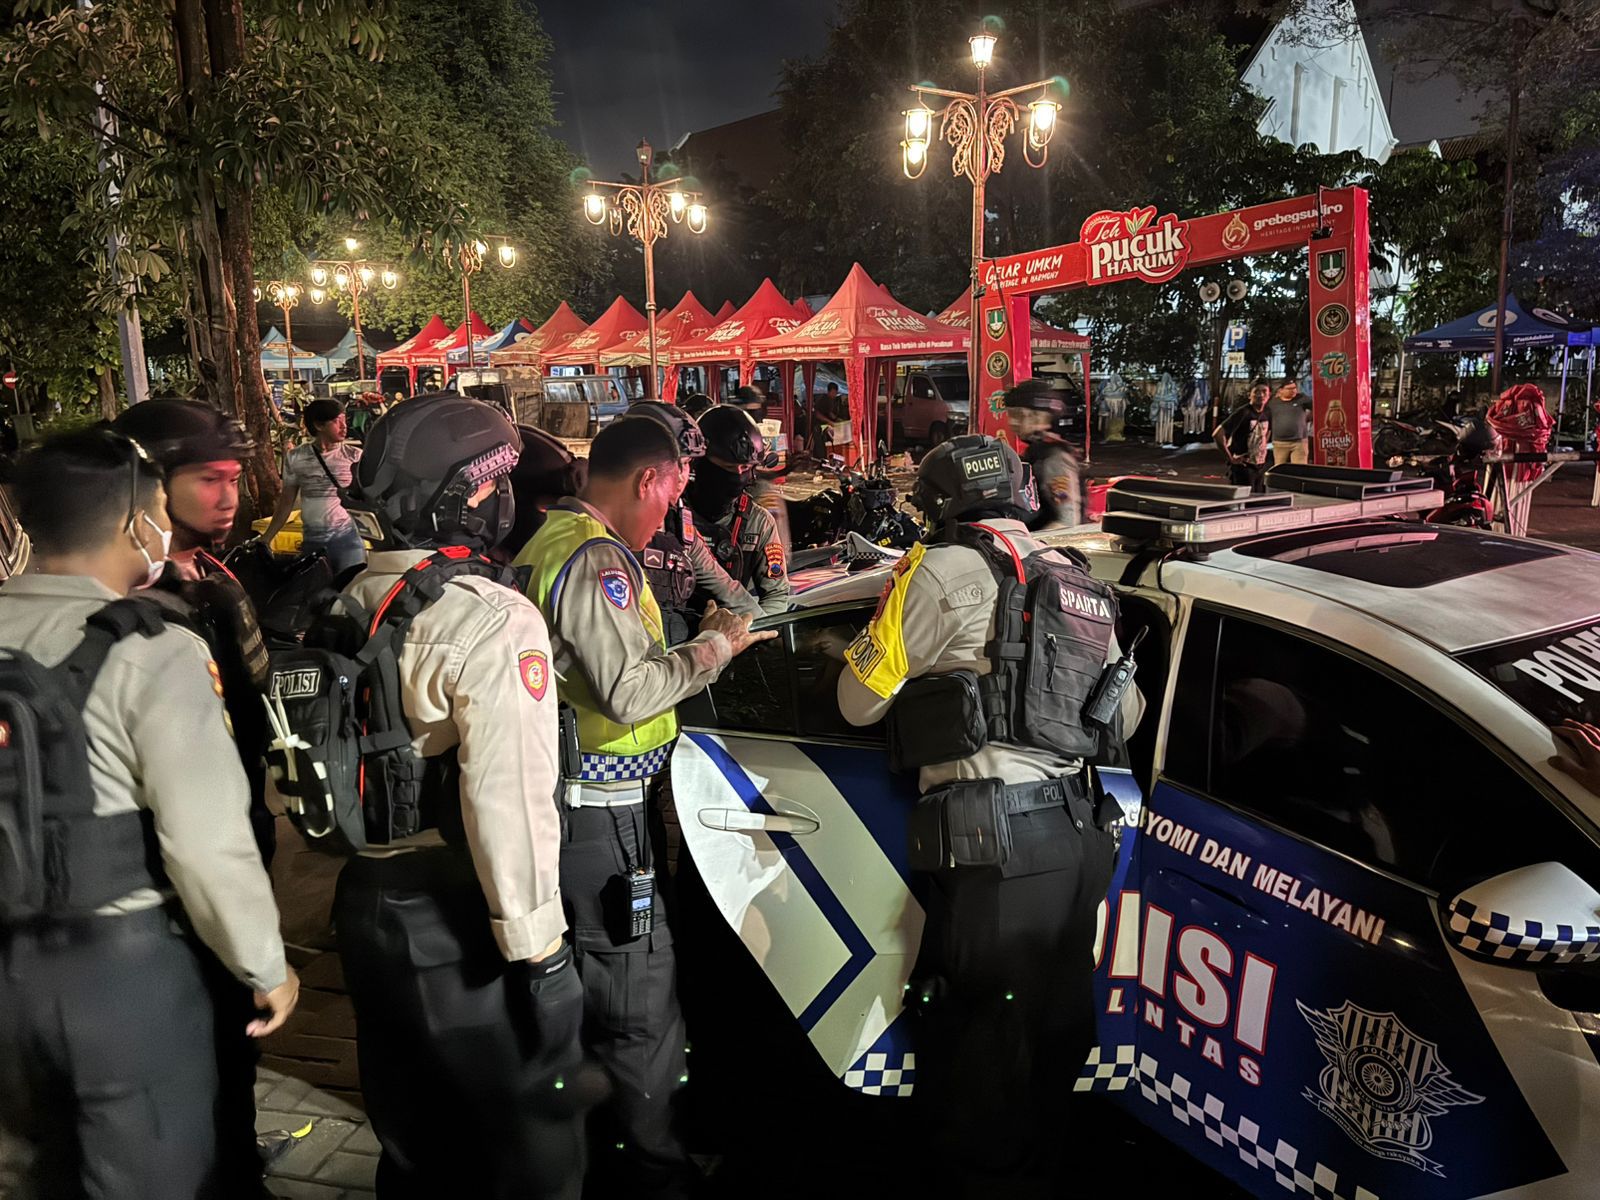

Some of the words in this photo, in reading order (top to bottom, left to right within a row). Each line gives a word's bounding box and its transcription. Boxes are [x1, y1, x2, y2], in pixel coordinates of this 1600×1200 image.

[1085, 217, 1121, 244] Teh
[1301, 219, 1335, 229] HARONY
[1091, 220, 1184, 279] pucuk
[1025, 254, 1063, 275] UMKM
[1107, 251, 1181, 278] HARUM
[1231, 327, 1244, 346] P
[1323, 358, 1344, 375] 76
[965, 456, 1000, 474] POLICE
[1060, 587, 1111, 618] SPARTA
[273, 672, 318, 695] POLISI
[1199, 838, 1251, 880] DAN
[1252, 864, 1387, 946] MELAYANI
[1106, 987, 1262, 1086] LNTAS
[1363, 1047, 1402, 1071] POLISI
